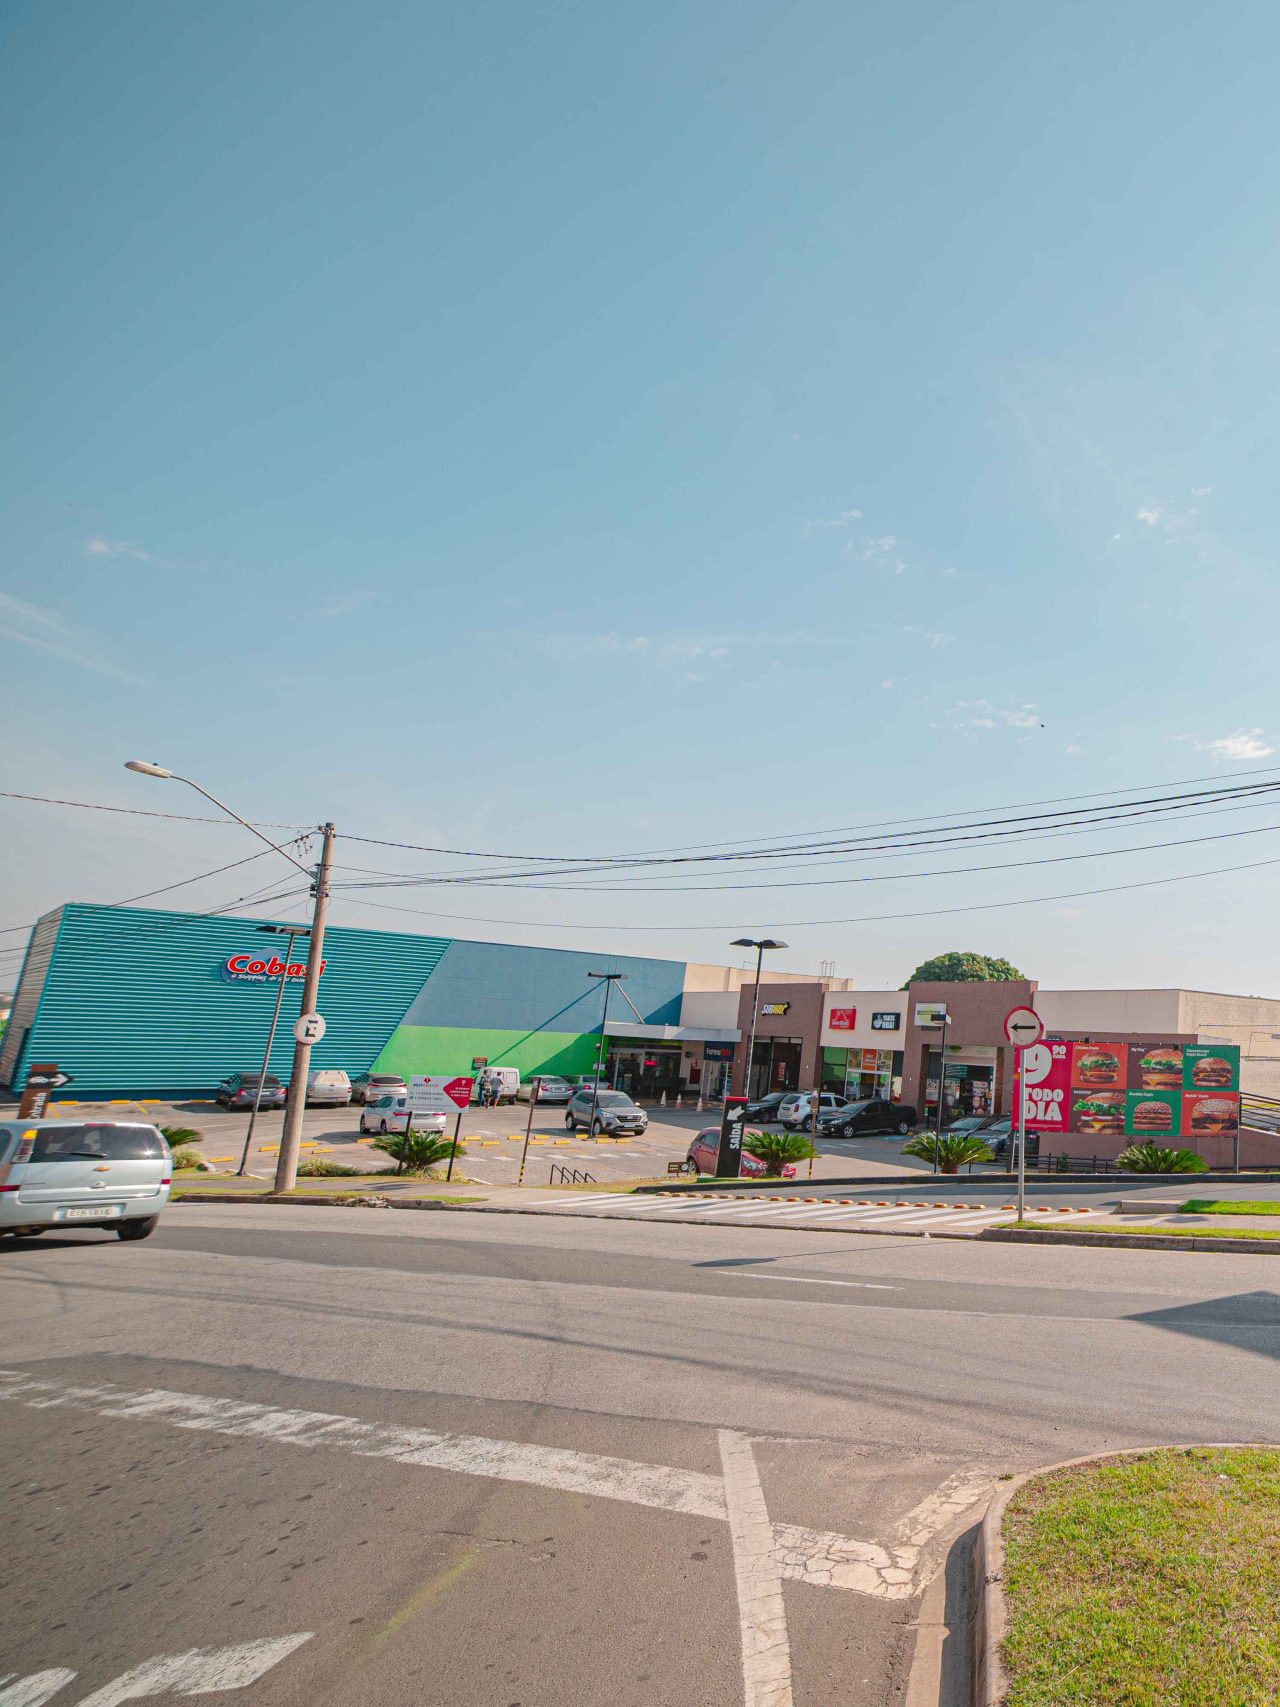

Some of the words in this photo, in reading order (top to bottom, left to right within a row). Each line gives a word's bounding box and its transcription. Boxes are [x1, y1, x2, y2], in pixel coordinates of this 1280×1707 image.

[762, 1004, 788, 1015] SUBWAY
[1052, 1044, 1067, 1055] 90
[1024, 1087, 1064, 1102] TODO
[1024, 1100, 1063, 1122] DIA
[729, 1122, 742, 1149] SAÍDA
